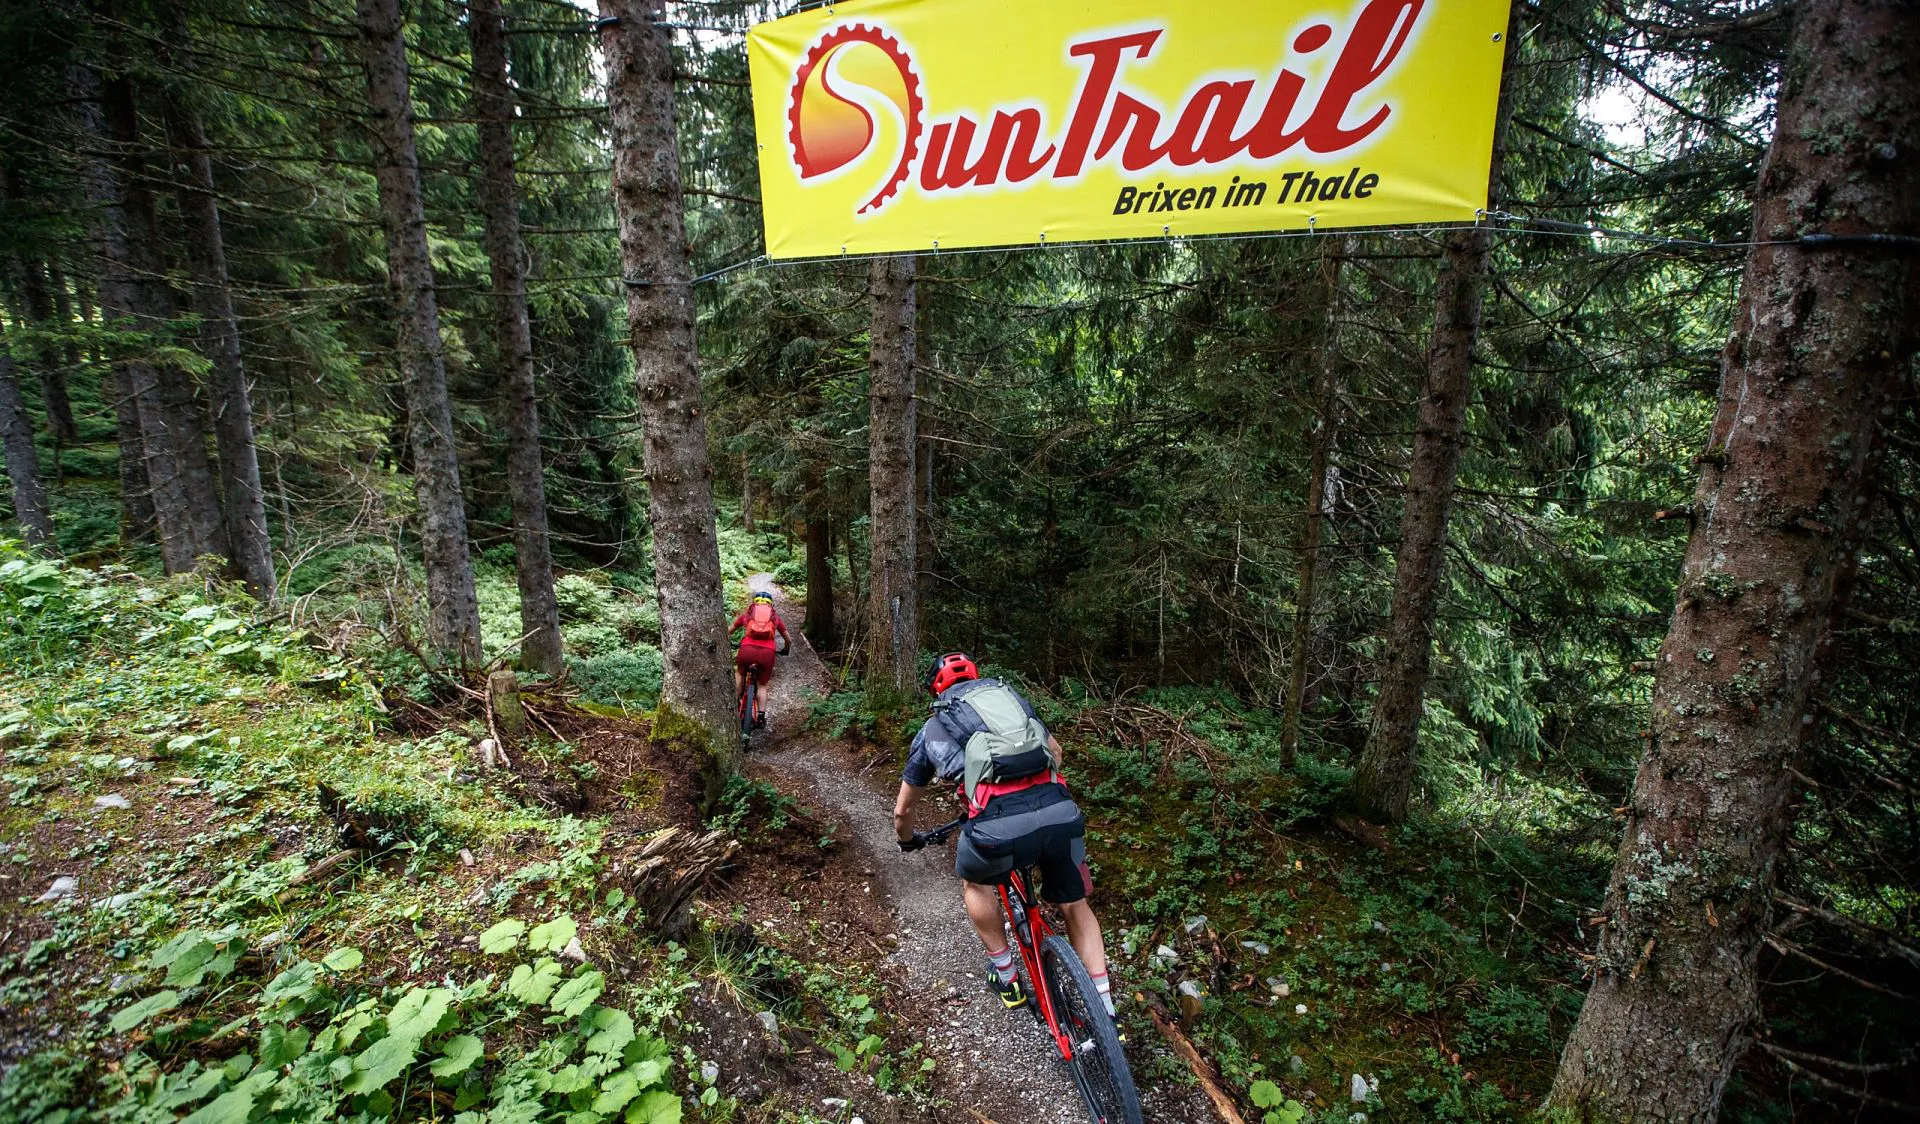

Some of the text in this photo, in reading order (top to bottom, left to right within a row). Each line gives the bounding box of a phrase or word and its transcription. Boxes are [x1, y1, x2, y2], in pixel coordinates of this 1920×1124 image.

[1112, 167, 1380, 216] Brixen im Thale
